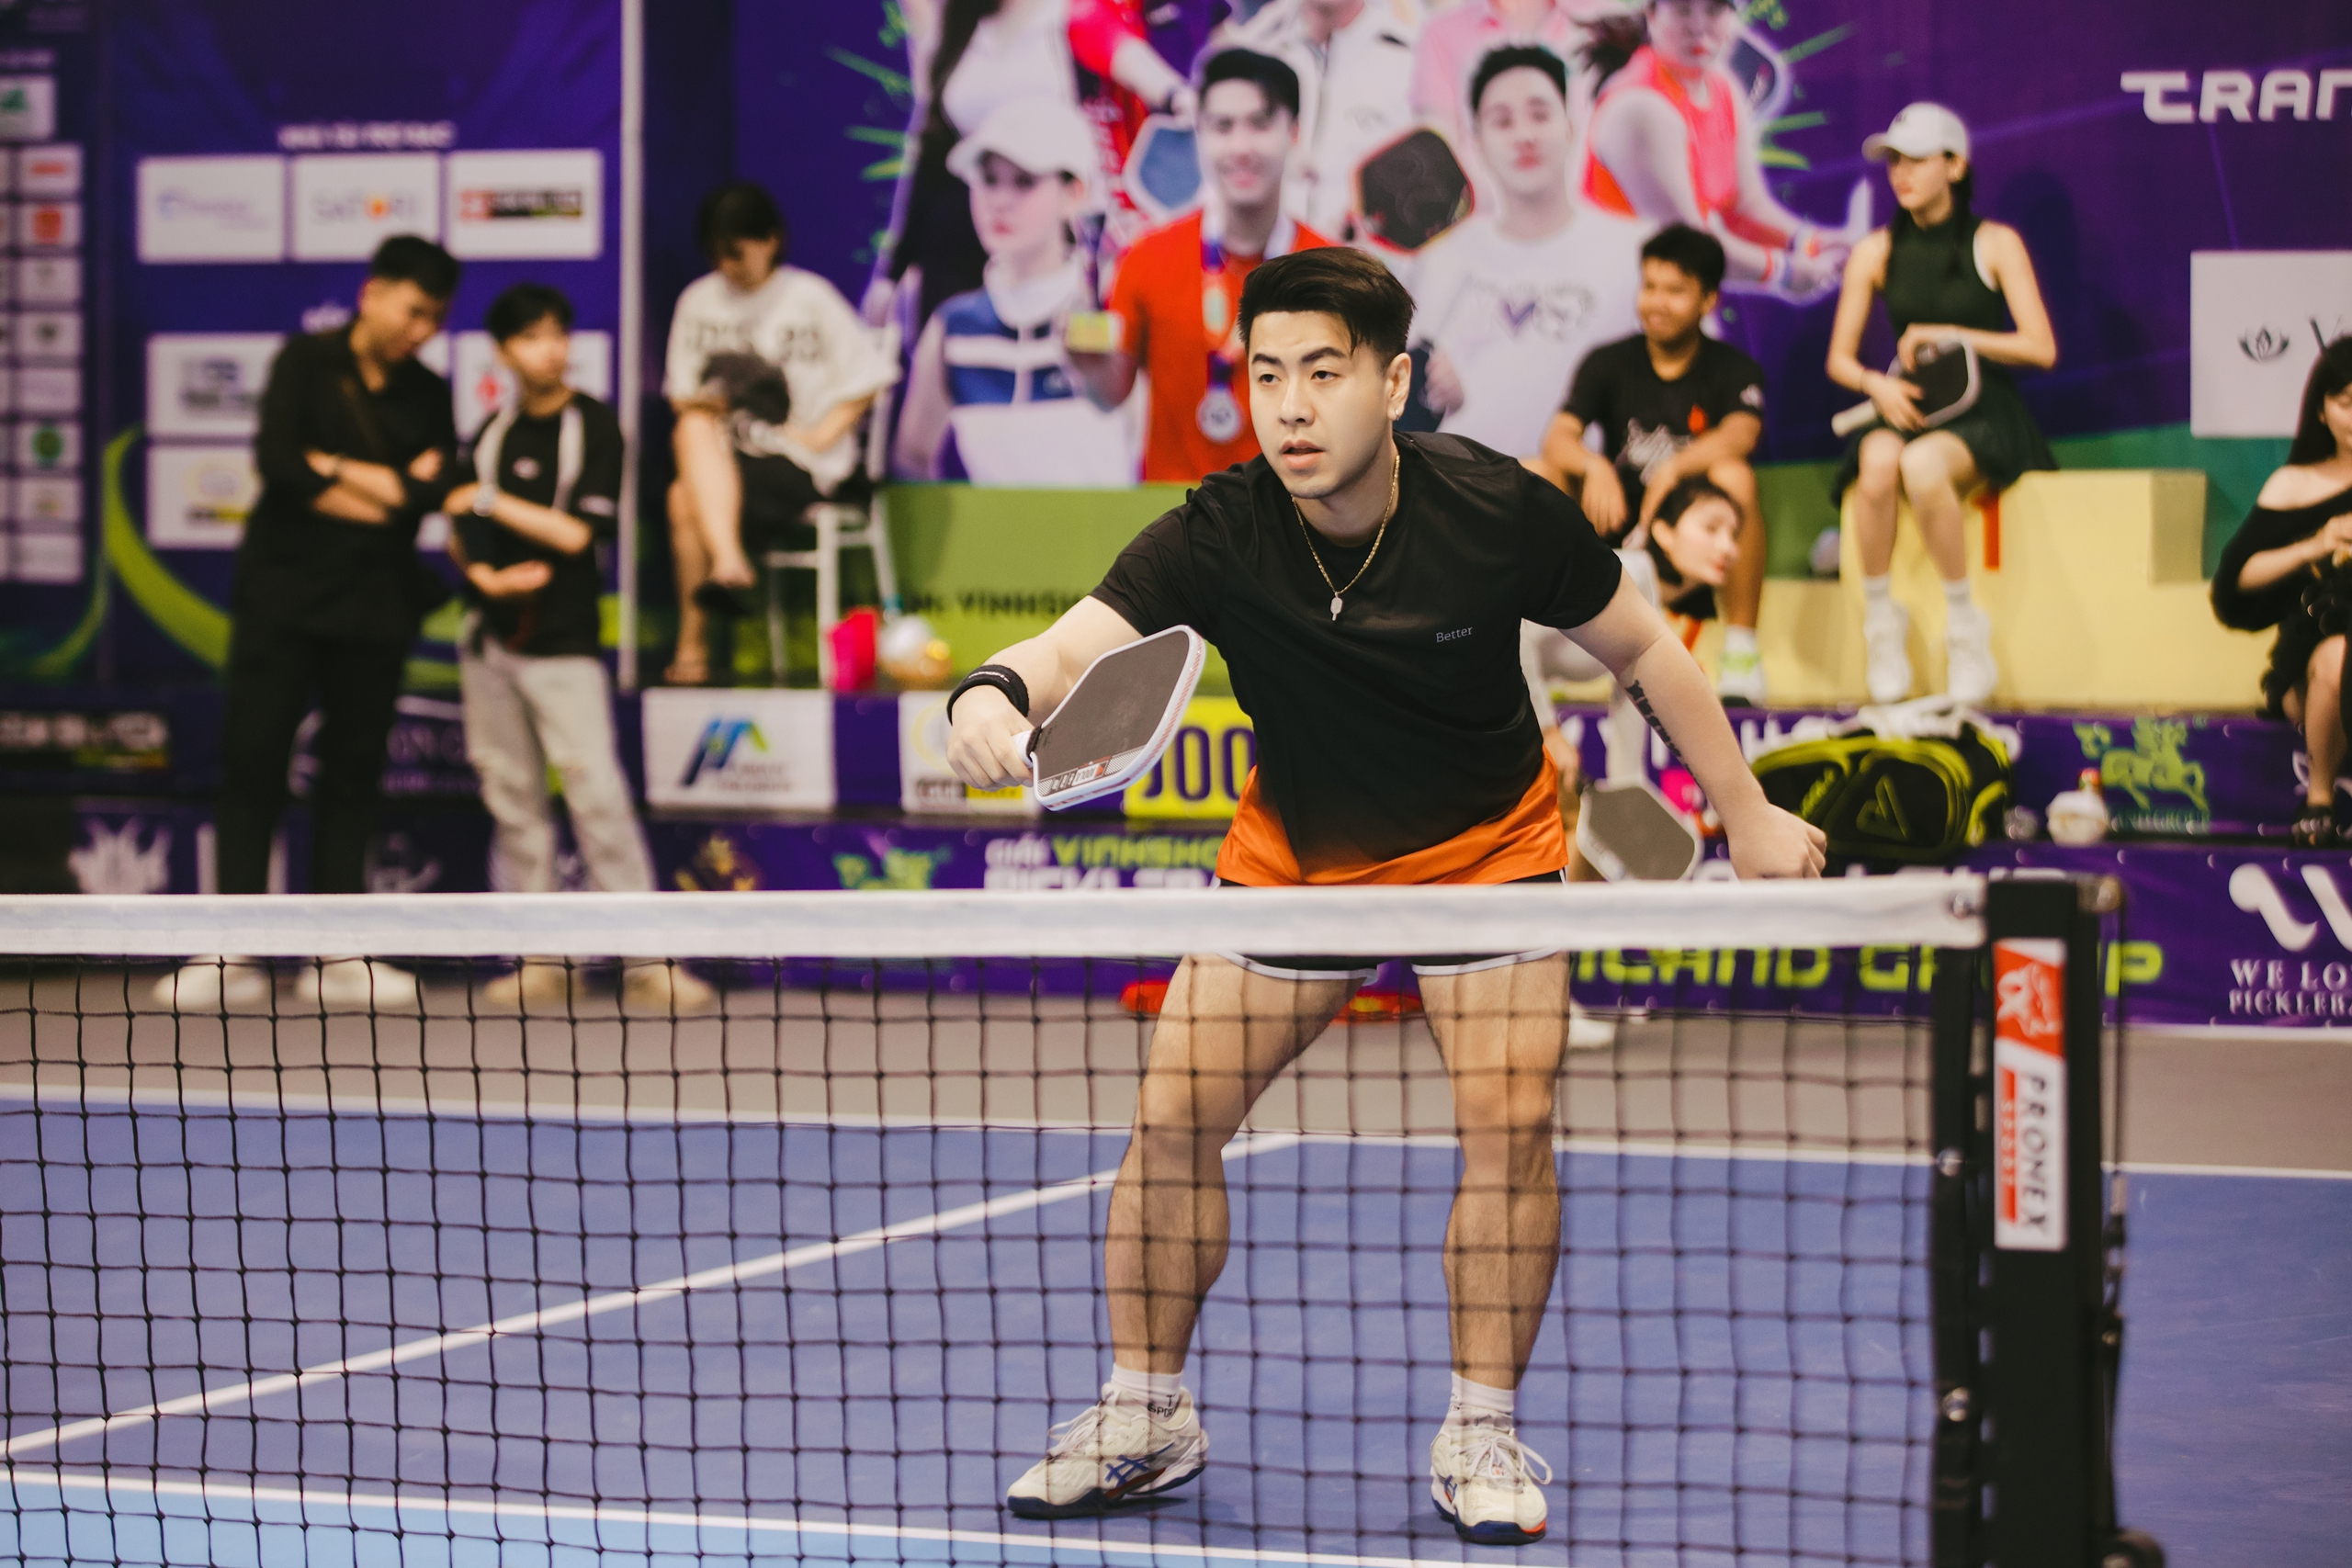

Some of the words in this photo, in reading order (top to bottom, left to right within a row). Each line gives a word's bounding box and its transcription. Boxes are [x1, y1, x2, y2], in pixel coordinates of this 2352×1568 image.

[1435, 626, 1473, 643] Better
[2230, 959, 2284, 989] WE
[2301, 961, 2352, 992] LO
[2024, 1075, 2047, 1235] PRONEX
